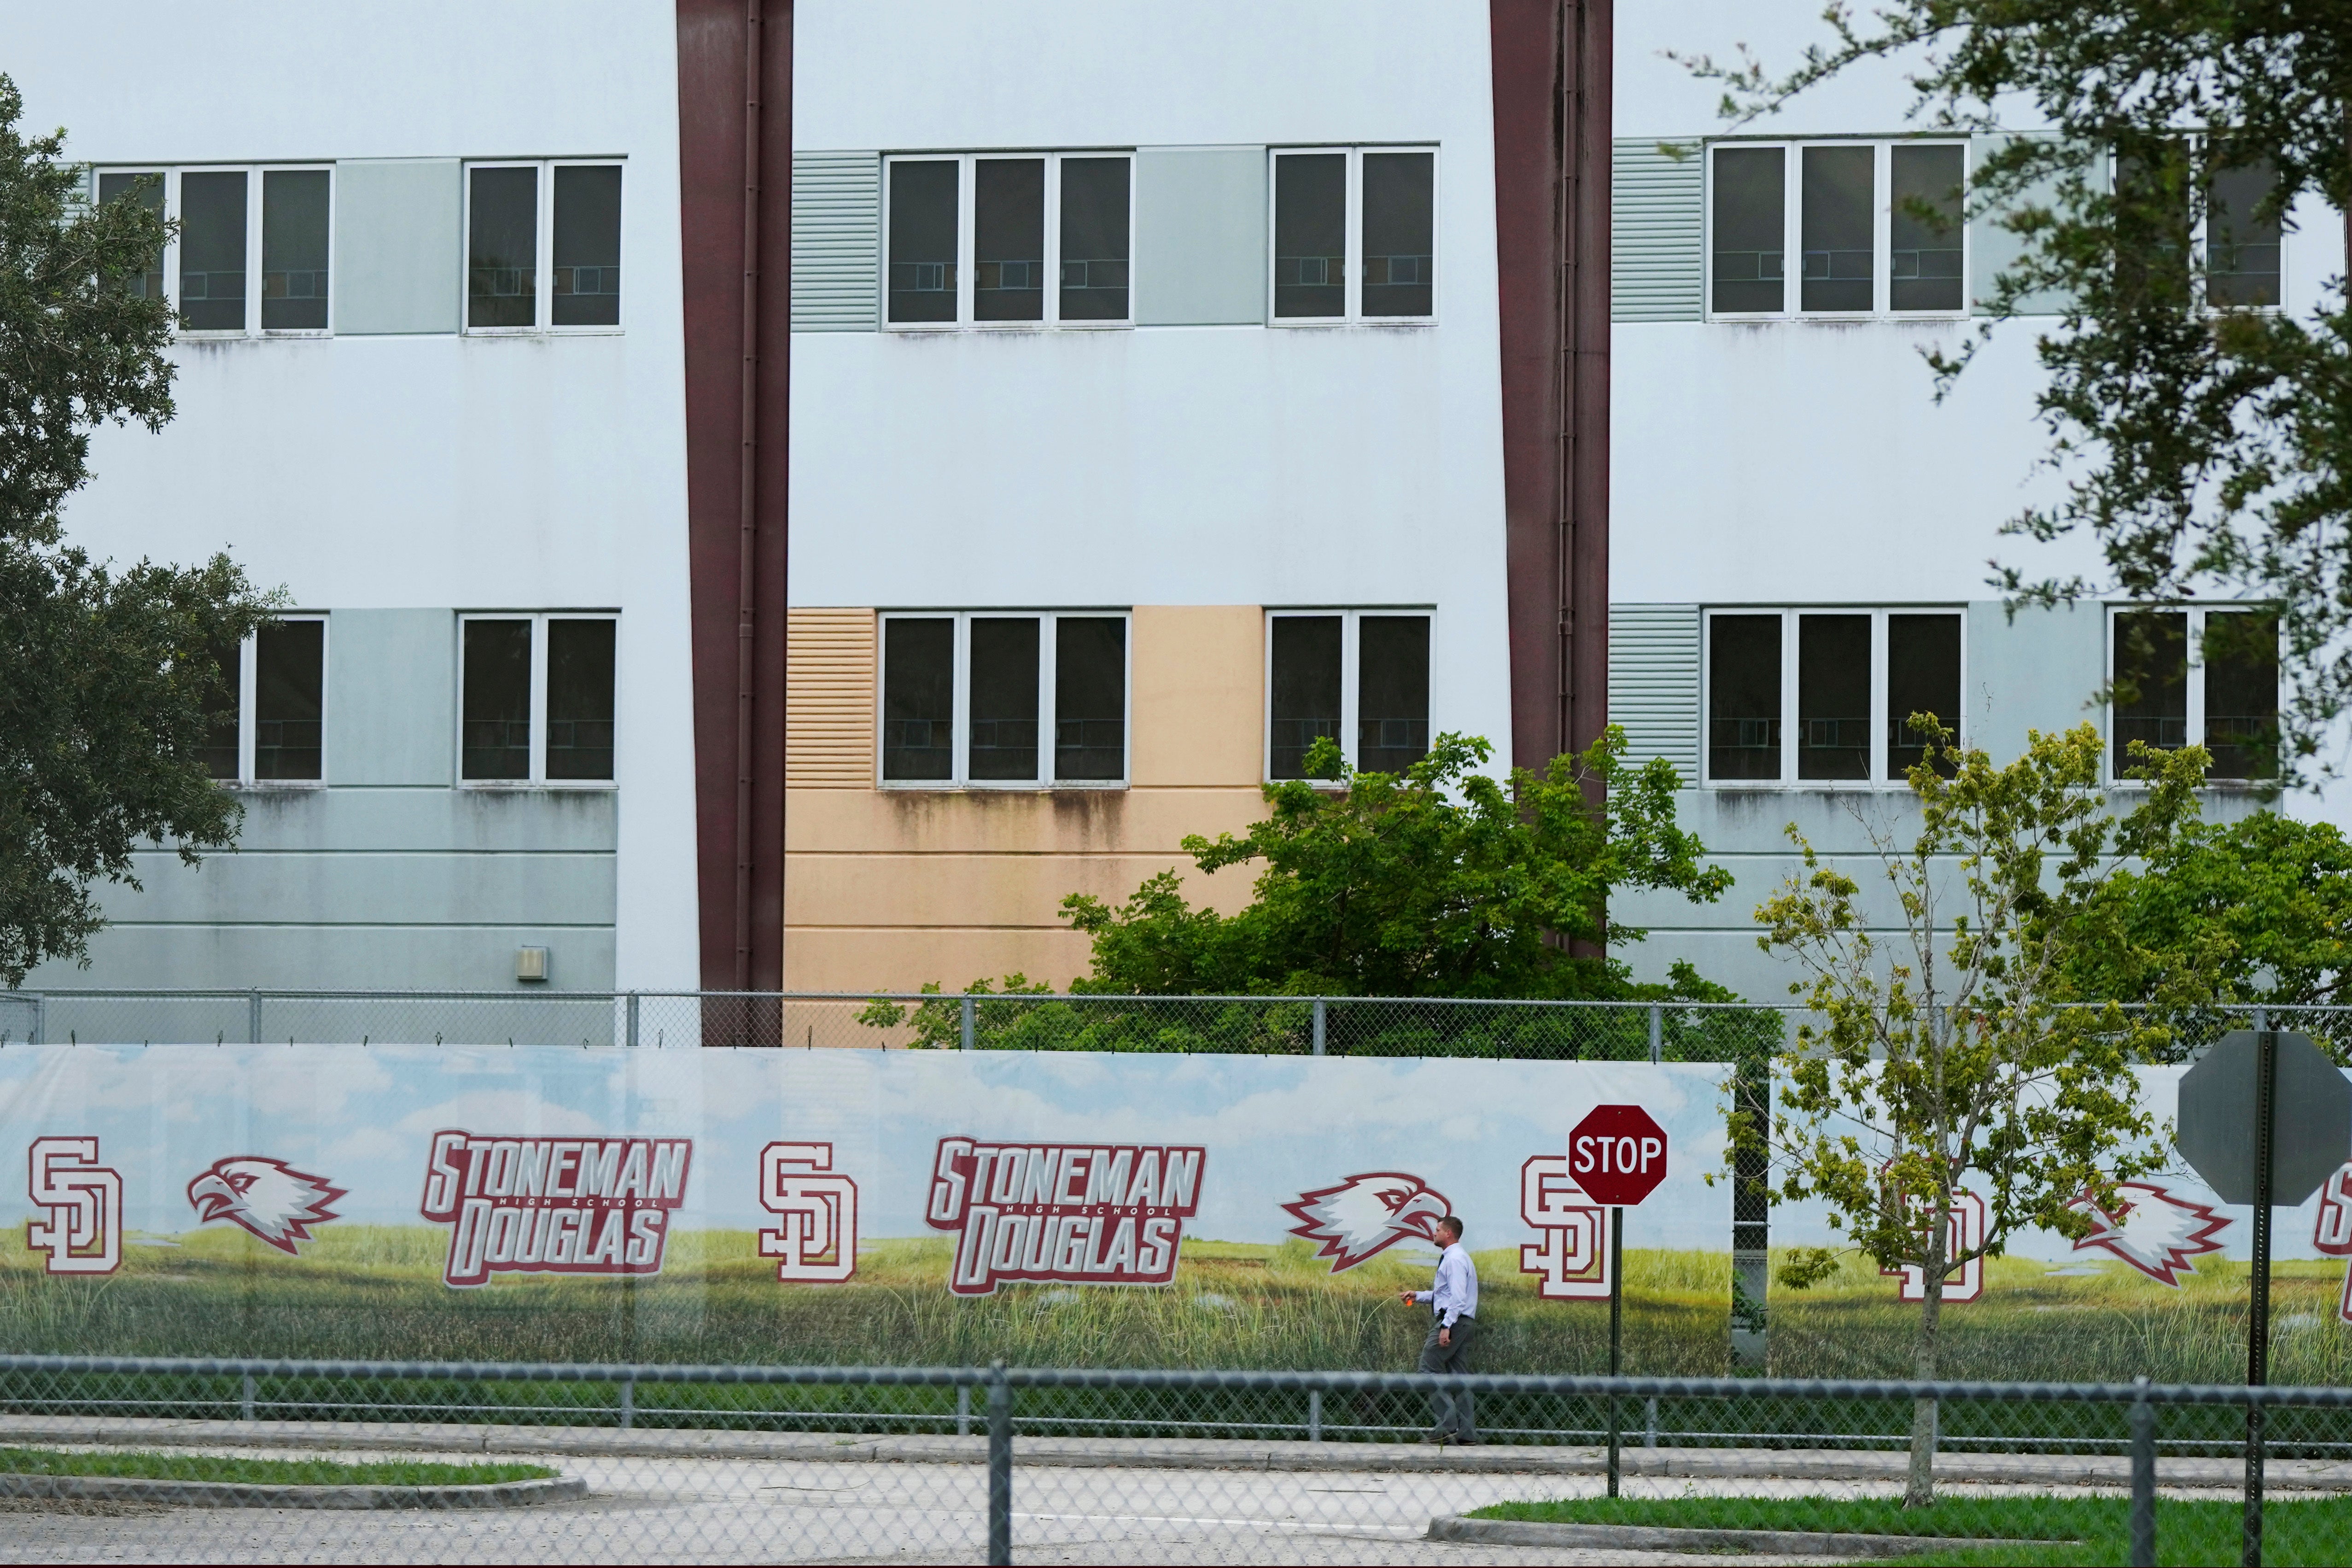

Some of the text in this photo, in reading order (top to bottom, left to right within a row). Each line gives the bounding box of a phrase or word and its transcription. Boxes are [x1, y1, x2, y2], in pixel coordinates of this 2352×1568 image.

[425, 1133, 688, 1214] STONEMAN
[929, 1140, 1201, 1221] STONEMAN
[1574, 1136, 1662, 1174] STOP
[450, 1198, 664, 1277] DOUGLAS
[572, 1199, 659, 1207] SCHOOL
[1006, 1205, 1170, 1216] HIGH SCHOOL
[955, 1205, 1176, 1286] DOUGLAS
